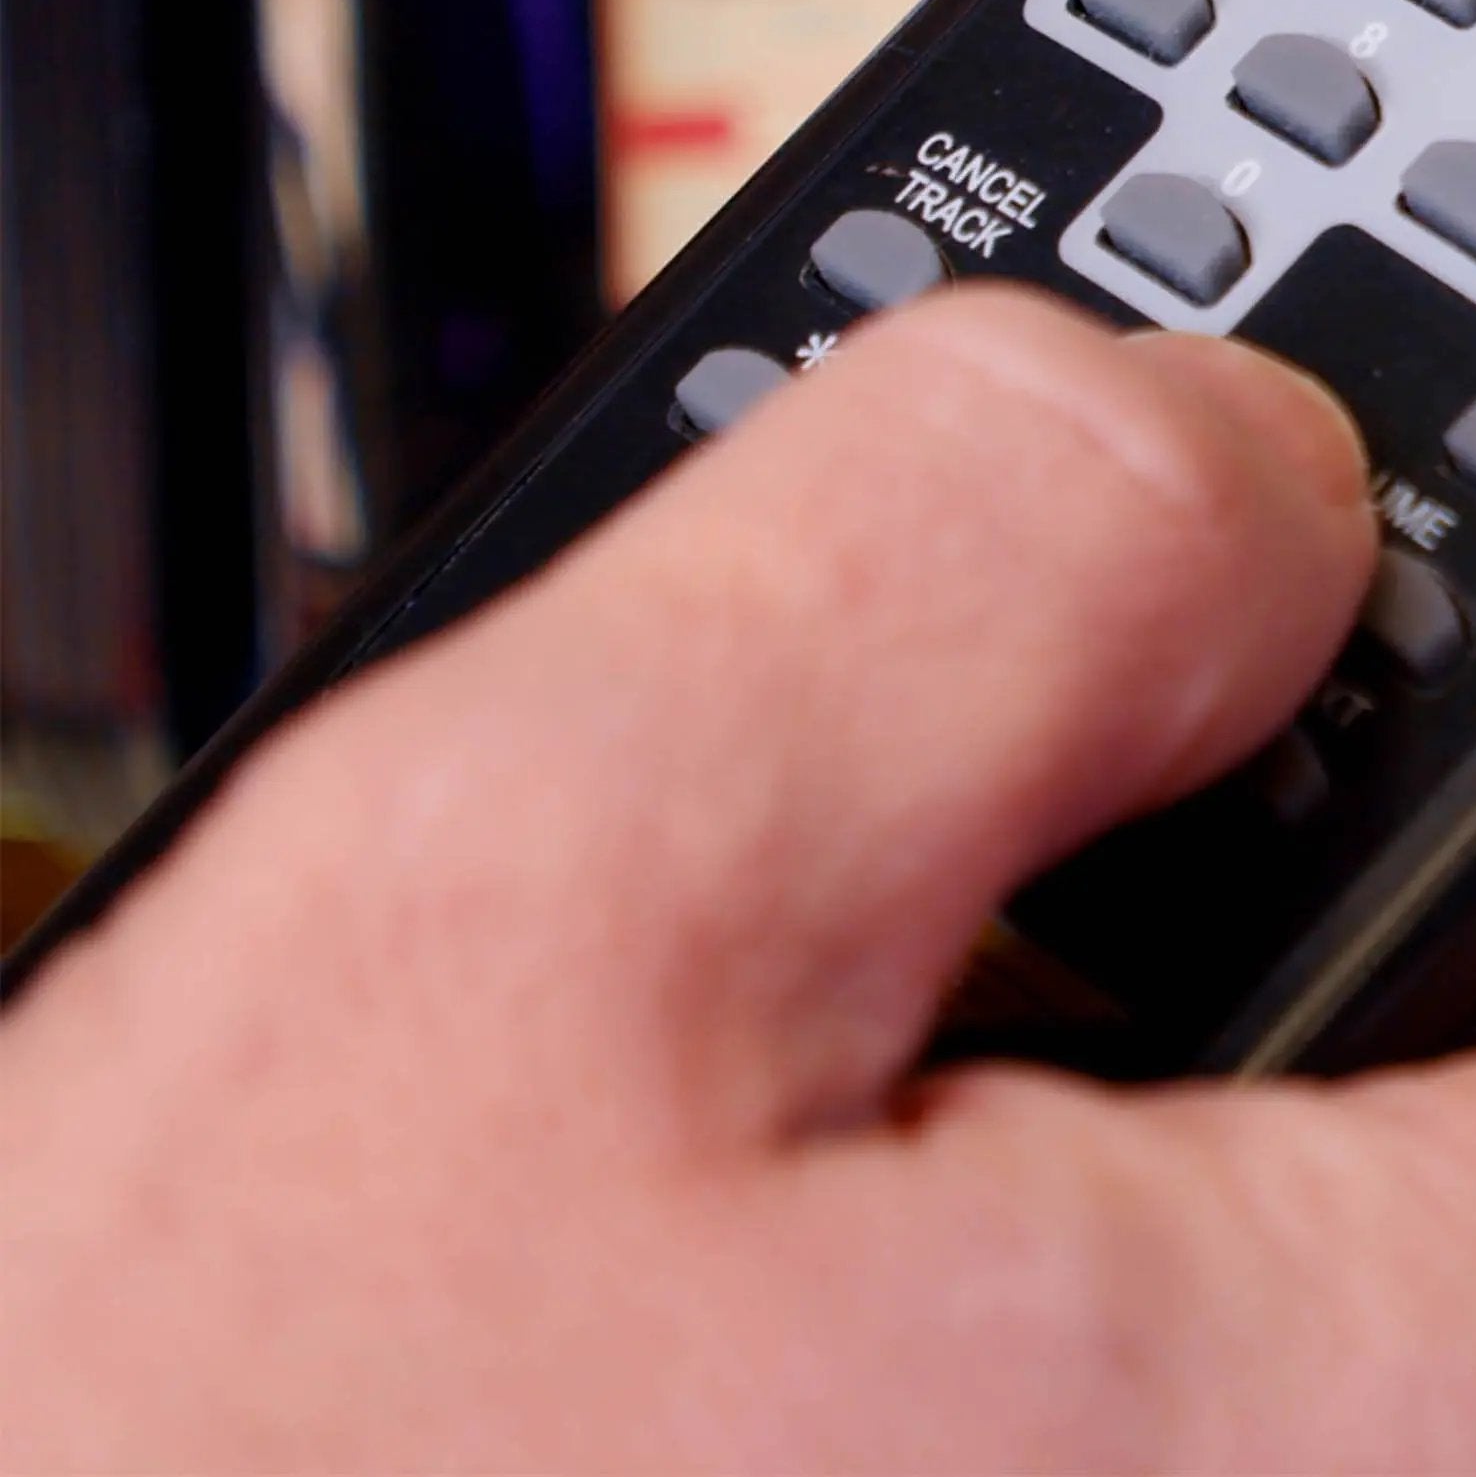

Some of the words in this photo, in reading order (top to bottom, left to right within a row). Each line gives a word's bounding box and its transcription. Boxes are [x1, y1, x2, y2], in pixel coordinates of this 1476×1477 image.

[1348, 22, 1389, 59] 8
[916, 131, 1047, 229] CANCEL
[1220, 159, 1262, 197] 0
[894, 170, 1012, 258] TRACK
